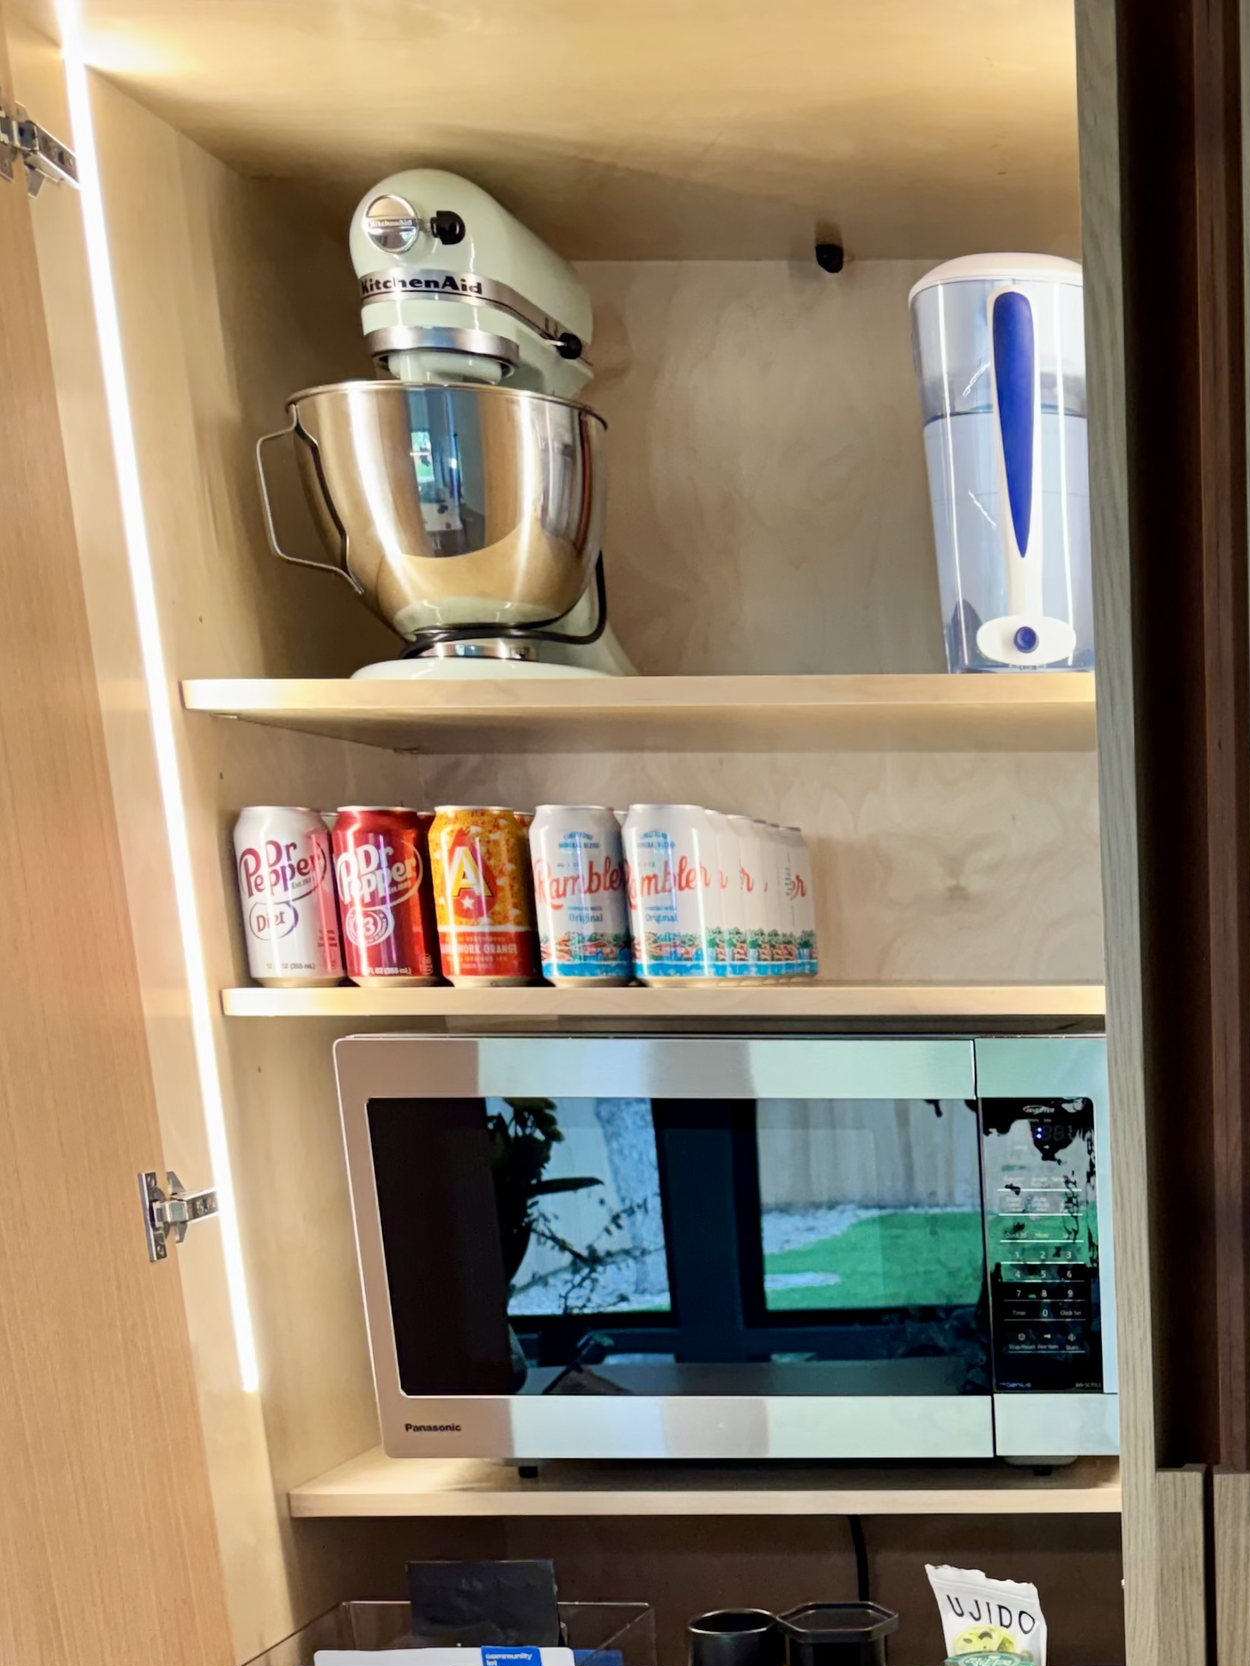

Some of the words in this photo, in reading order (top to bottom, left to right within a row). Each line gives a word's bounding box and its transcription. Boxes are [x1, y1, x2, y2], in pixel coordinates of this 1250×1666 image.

[361, 276, 482, 295] KitchenAid
[265, 840, 297, 862] Dr
[357, 843, 394, 868] Dr
[239, 848, 323, 899] Pepper
[449, 847, 493, 897] A
[256, 911, 286, 933] Diet
[404, 1422, 462, 1433] Panasonic
[946, 1593, 1036, 1635] UJIDO
[485, 1653, 533, 1662] community
[485, 1659, 498, 1666] lot
